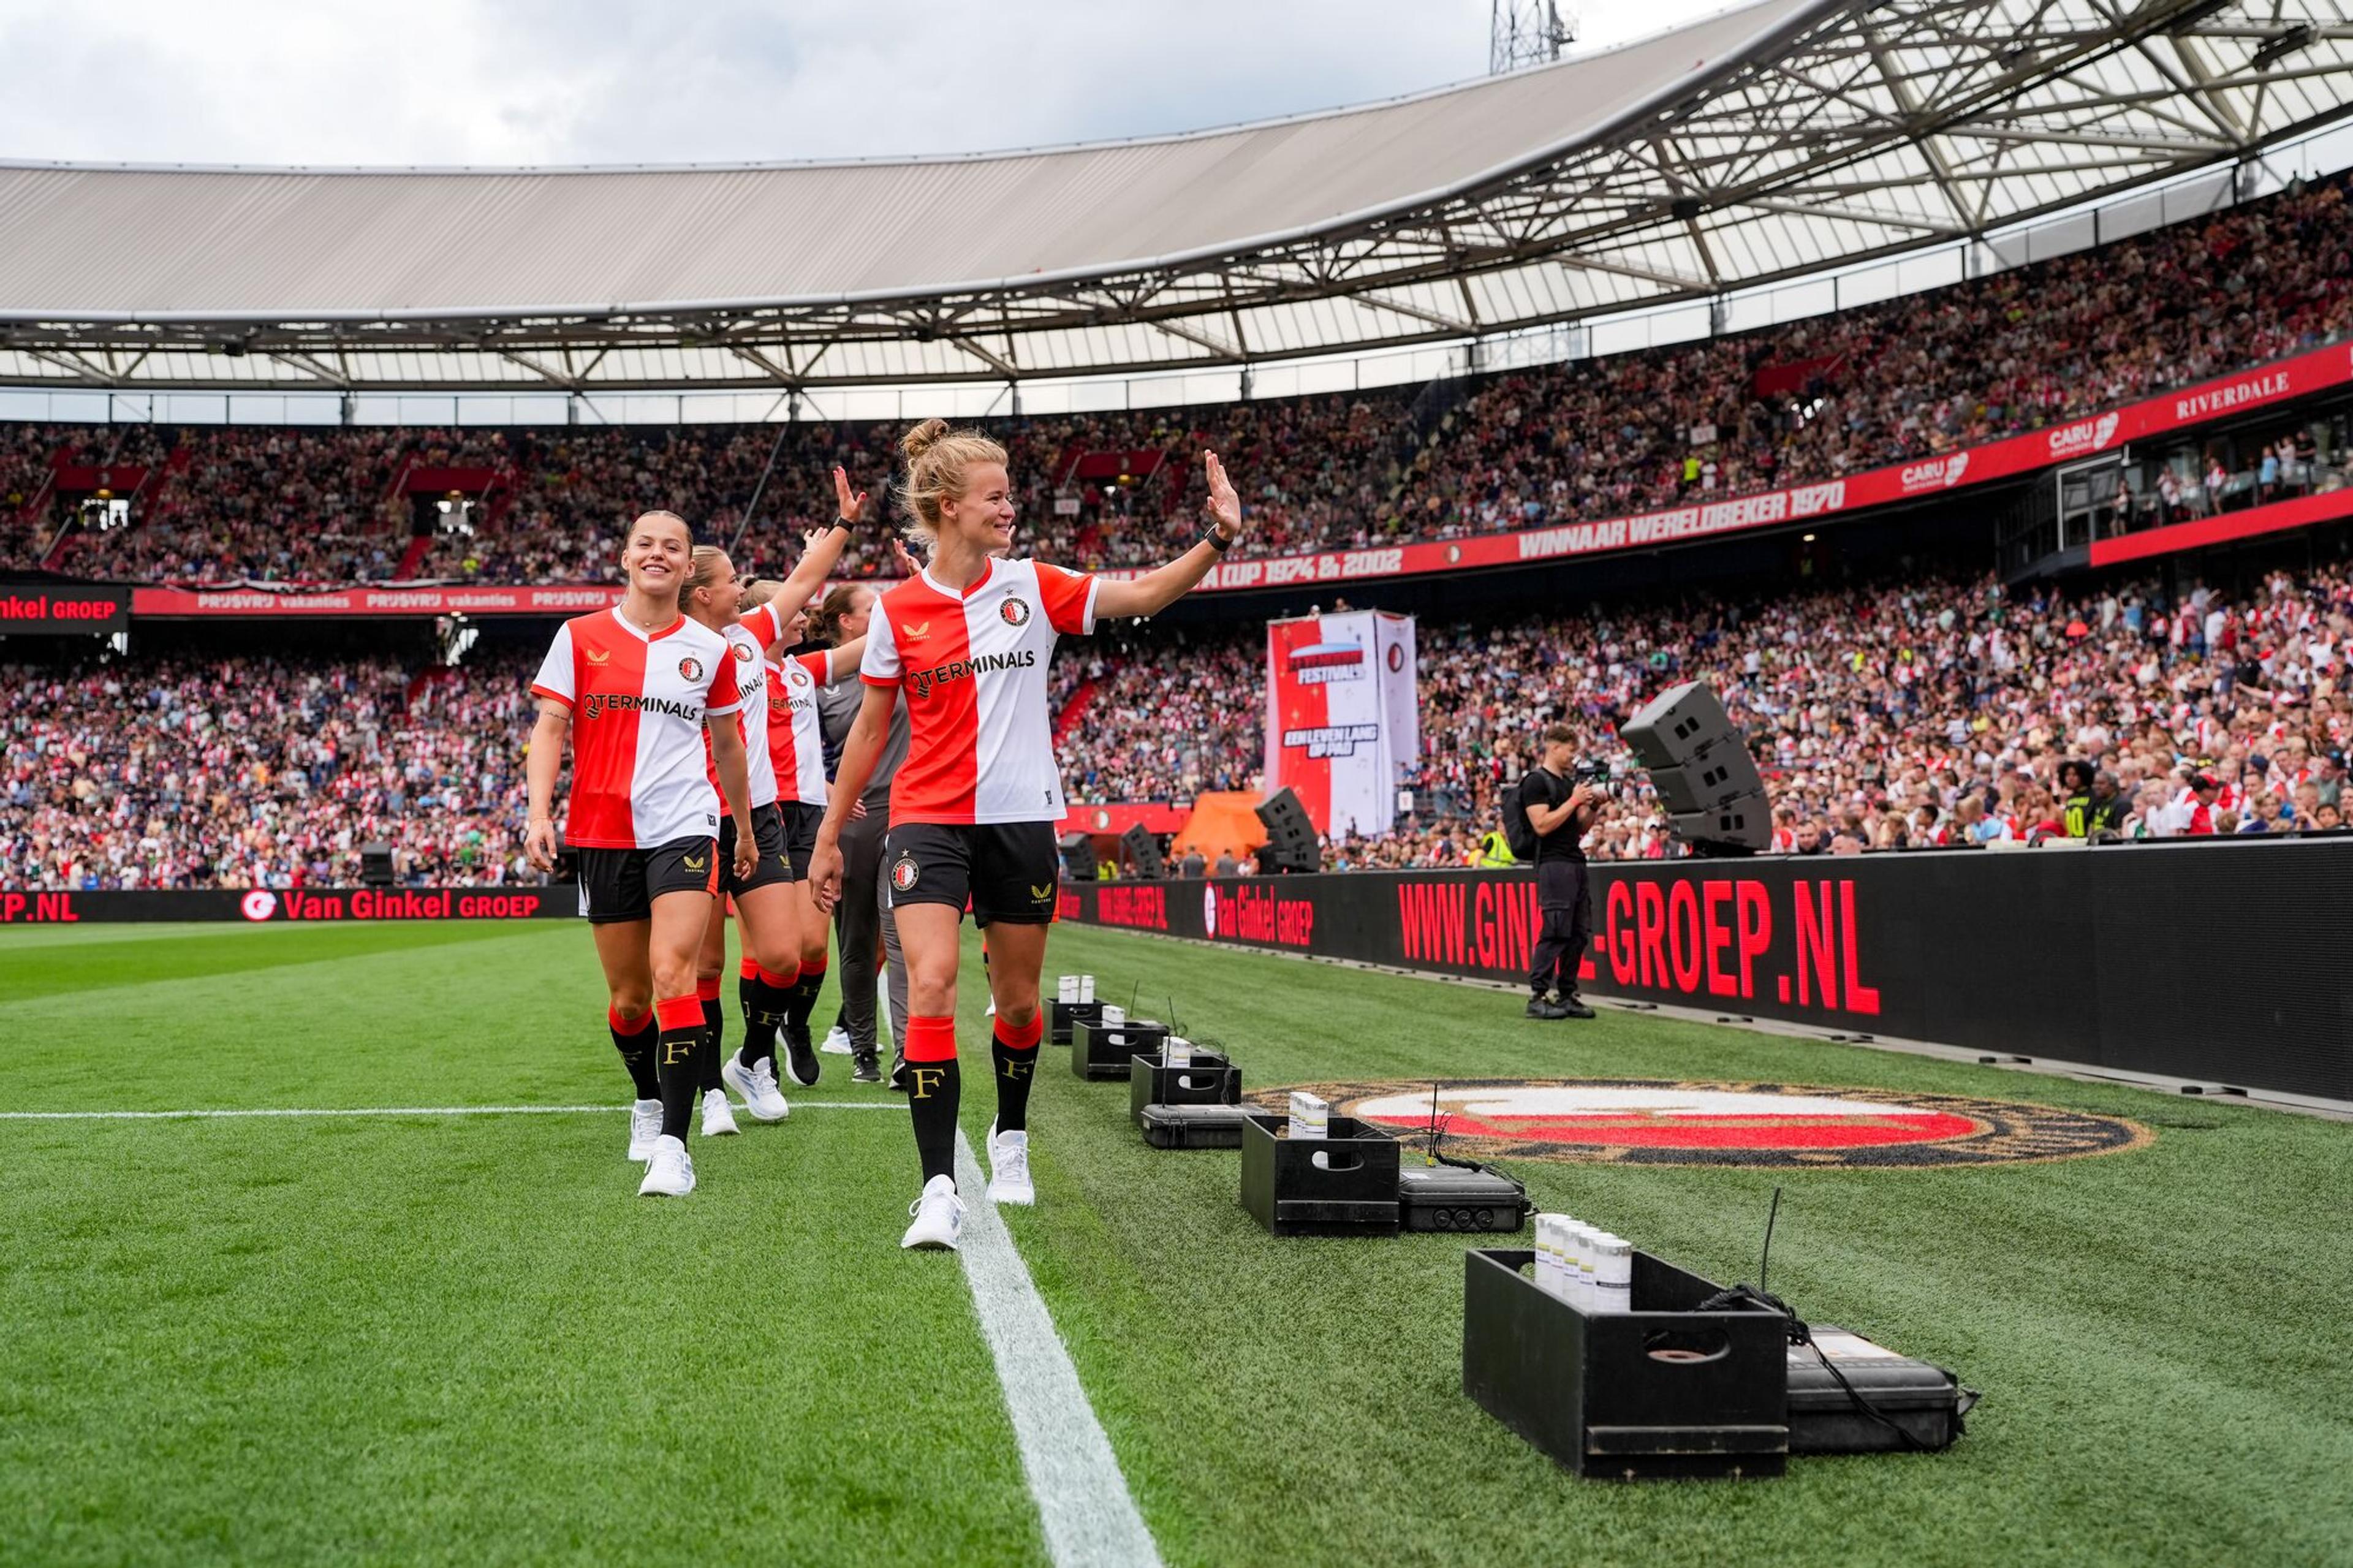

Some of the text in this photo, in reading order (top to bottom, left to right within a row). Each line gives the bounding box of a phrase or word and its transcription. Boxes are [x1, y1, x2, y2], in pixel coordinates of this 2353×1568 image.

[2177, 372, 2290, 420] RIVERDALE
[2048, 422, 2094, 448] CARU
[1901, 461, 1945, 484] CARU
[1519, 481, 1846, 558] WINNAAR WERELDBEKER 1970
[1222, 562, 1260, 586] CUP
[1264, 558, 1316, 583] 1974
[1318, 555, 1340, 579] &
[1343, 549, 1404, 576] 2002
[53, 600, 118, 620] GROEP
[283, 891, 343, 918] Van
[350, 890, 450, 918] Ginkel
[460, 896, 539, 917] GROEP
[1216, 885, 1314, 945] Van Ginkel GROEP
[664, 1040, 696, 1064] F
[1002, 1057, 1034, 1080] F
[911, 1068, 945, 1099] F
